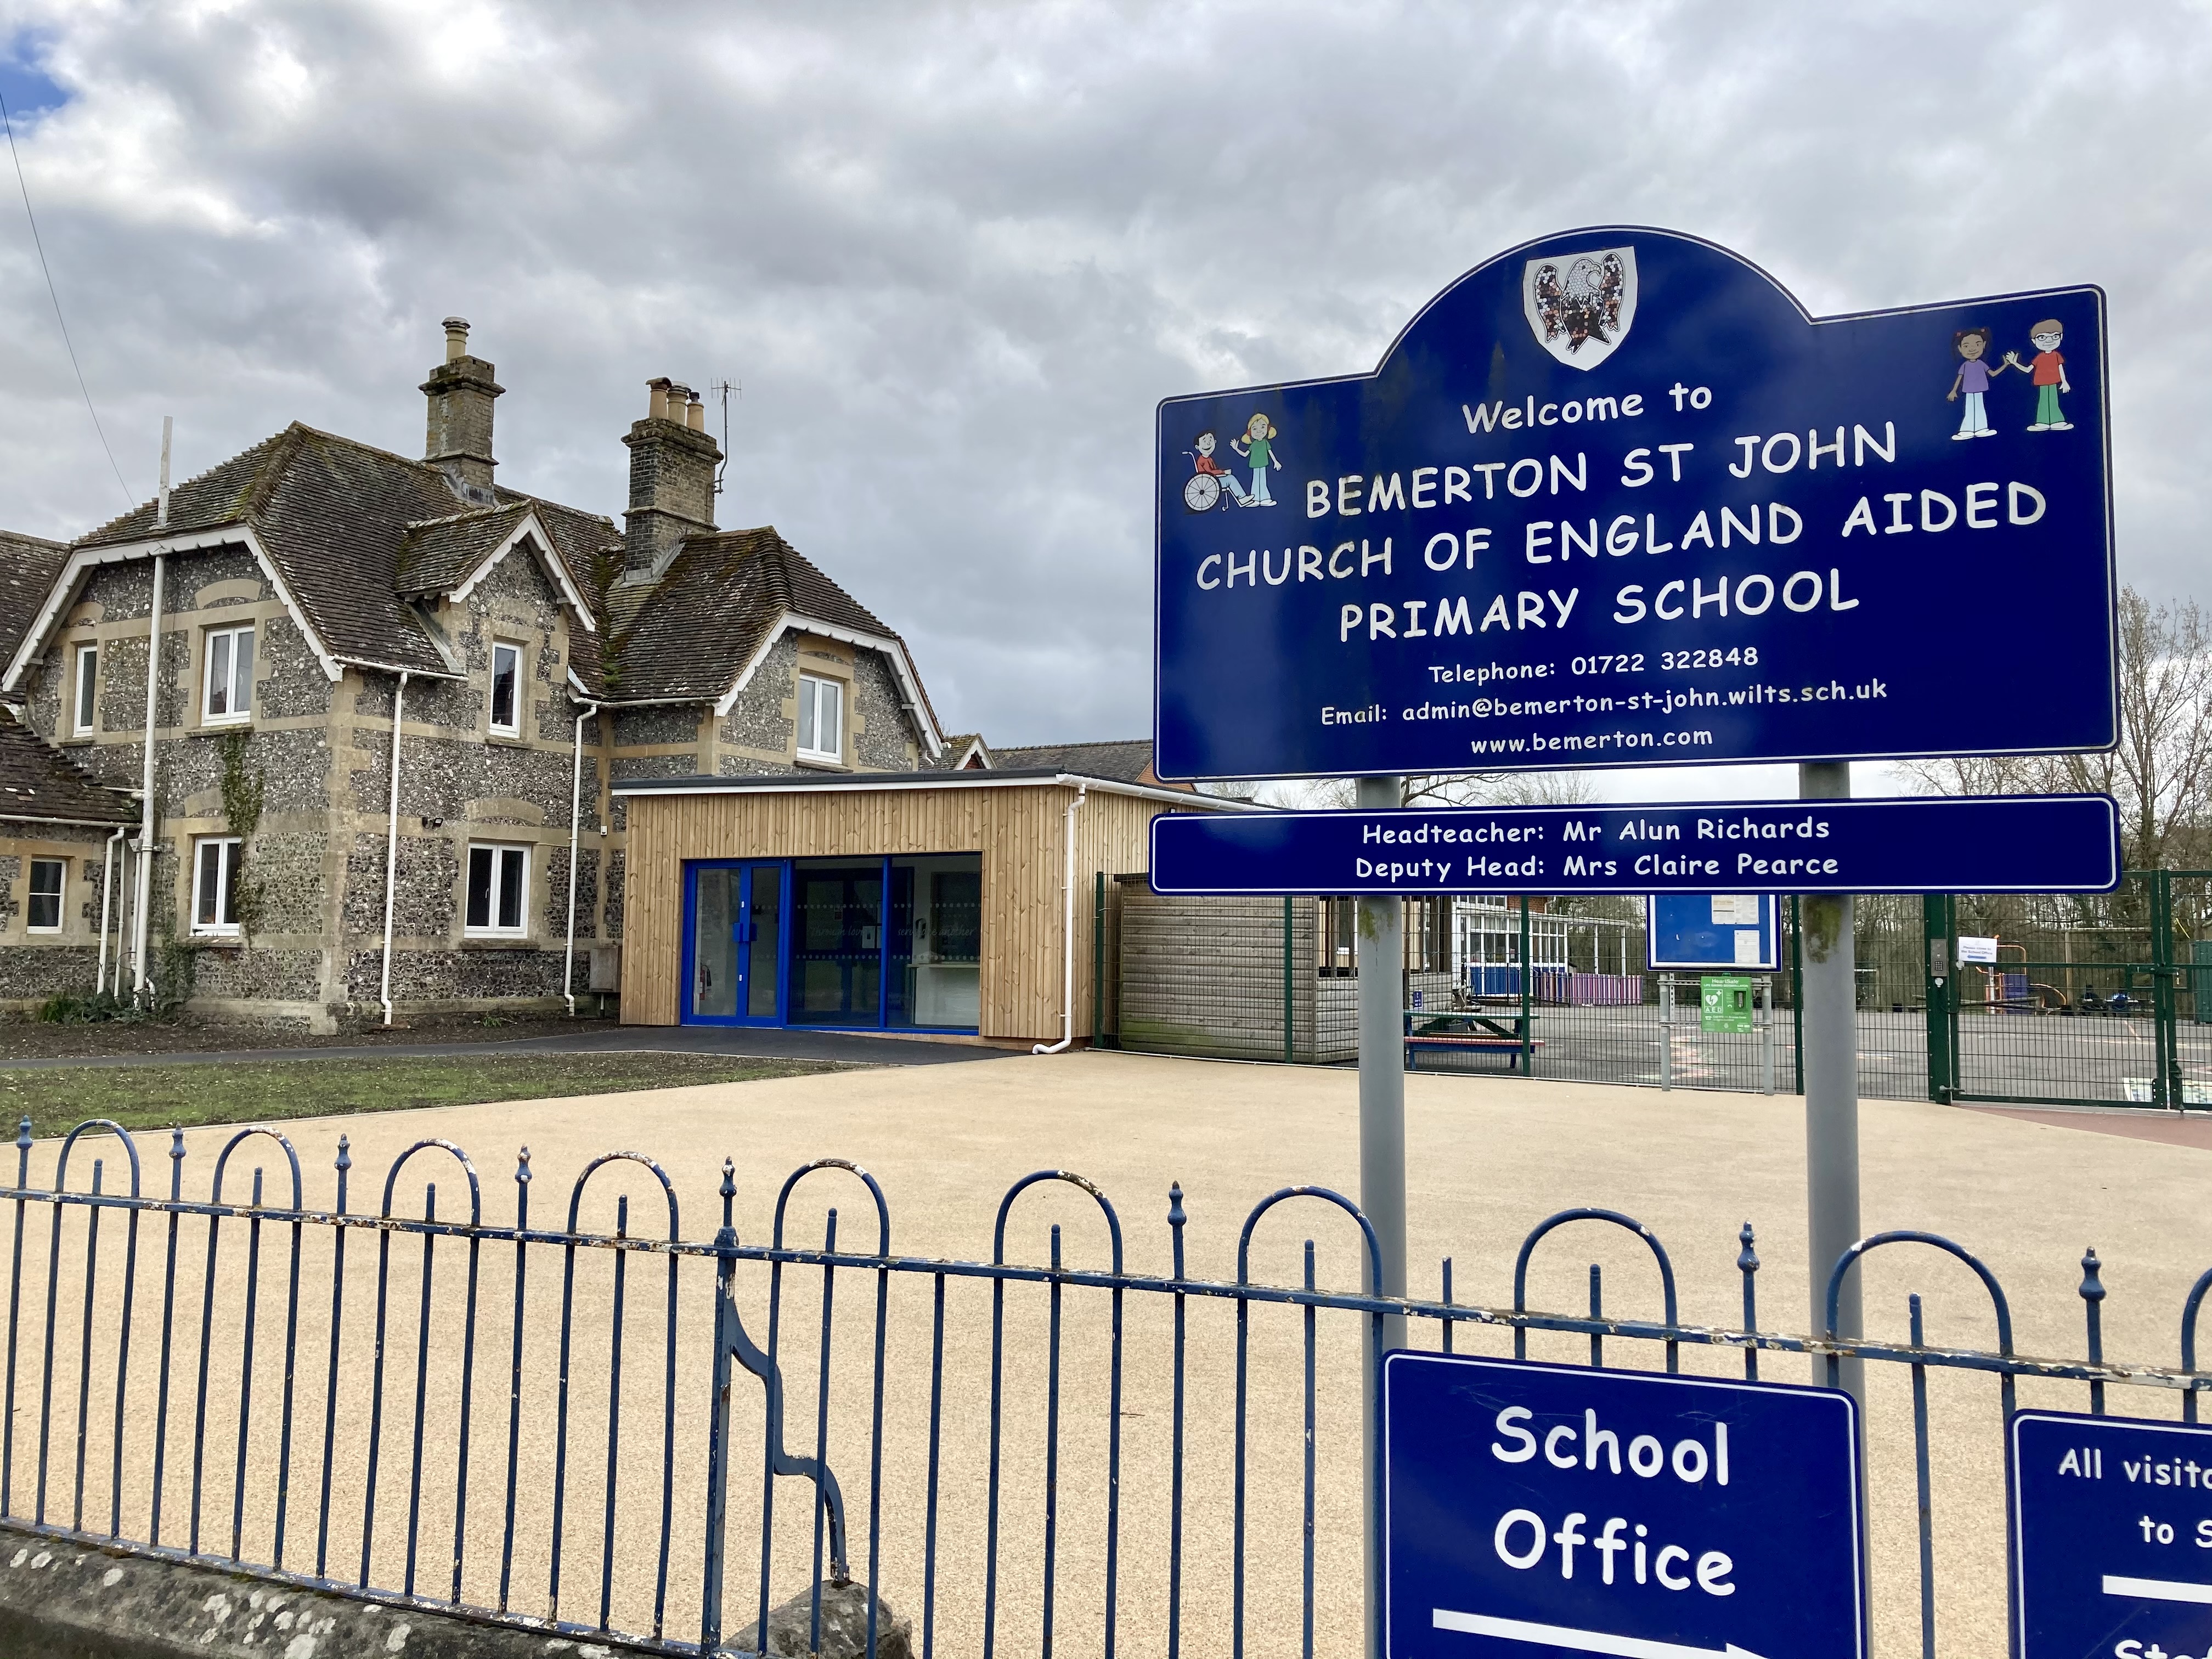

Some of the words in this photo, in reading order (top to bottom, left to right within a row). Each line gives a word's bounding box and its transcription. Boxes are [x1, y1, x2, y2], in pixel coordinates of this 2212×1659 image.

[1462, 394, 1644, 434] Welcome
[1668, 382, 1712, 412] to
[1307, 452, 1587, 518] BEMERTON
[1621, 443, 1694, 487] ST
[1728, 421, 1895, 478] JOHN
[1197, 537, 1392, 590] CHURCH
[1424, 528, 1492, 571] OF
[1526, 502, 1803, 564] ENGLAND
[1841, 481, 2046, 538] AIDED
[1341, 588, 1579, 642] PRIMARY
[1613, 568, 1859, 624] SCHOOL
[1428, 661, 1555, 686] Telephone:
[1571, 653, 1645, 675] 01722
[1661, 647, 1758, 670] 322848
[1322, 704, 1387, 725] Email:
[1402, 678, 1887, 721] admin@bemerton-st-john.wilts.sch.uk
[1471, 730, 1713, 754] www.bemerton.com
[1363, 821, 1543, 844] Headteacher:
[1563, 821, 1601, 842] Mr
[1619, 819, 1680, 840] Alun
[1697, 816, 1829, 839] Richards
[1356, 857, 1451, 883] Deputy
[1467, 855, 1544, 876] Head:
[1564, 855, 1617, 876] Mrs
[1634, 854, 1720, 876] Claire
[1737, 853, 1838, 874] Pearce
[1491, 1406, 1729, 1486] School
[2058, 1448, 2102, 1479] All
[1494, 1509, 1736, 1596] Office
[2138, 1515, 2174, 1544] to
